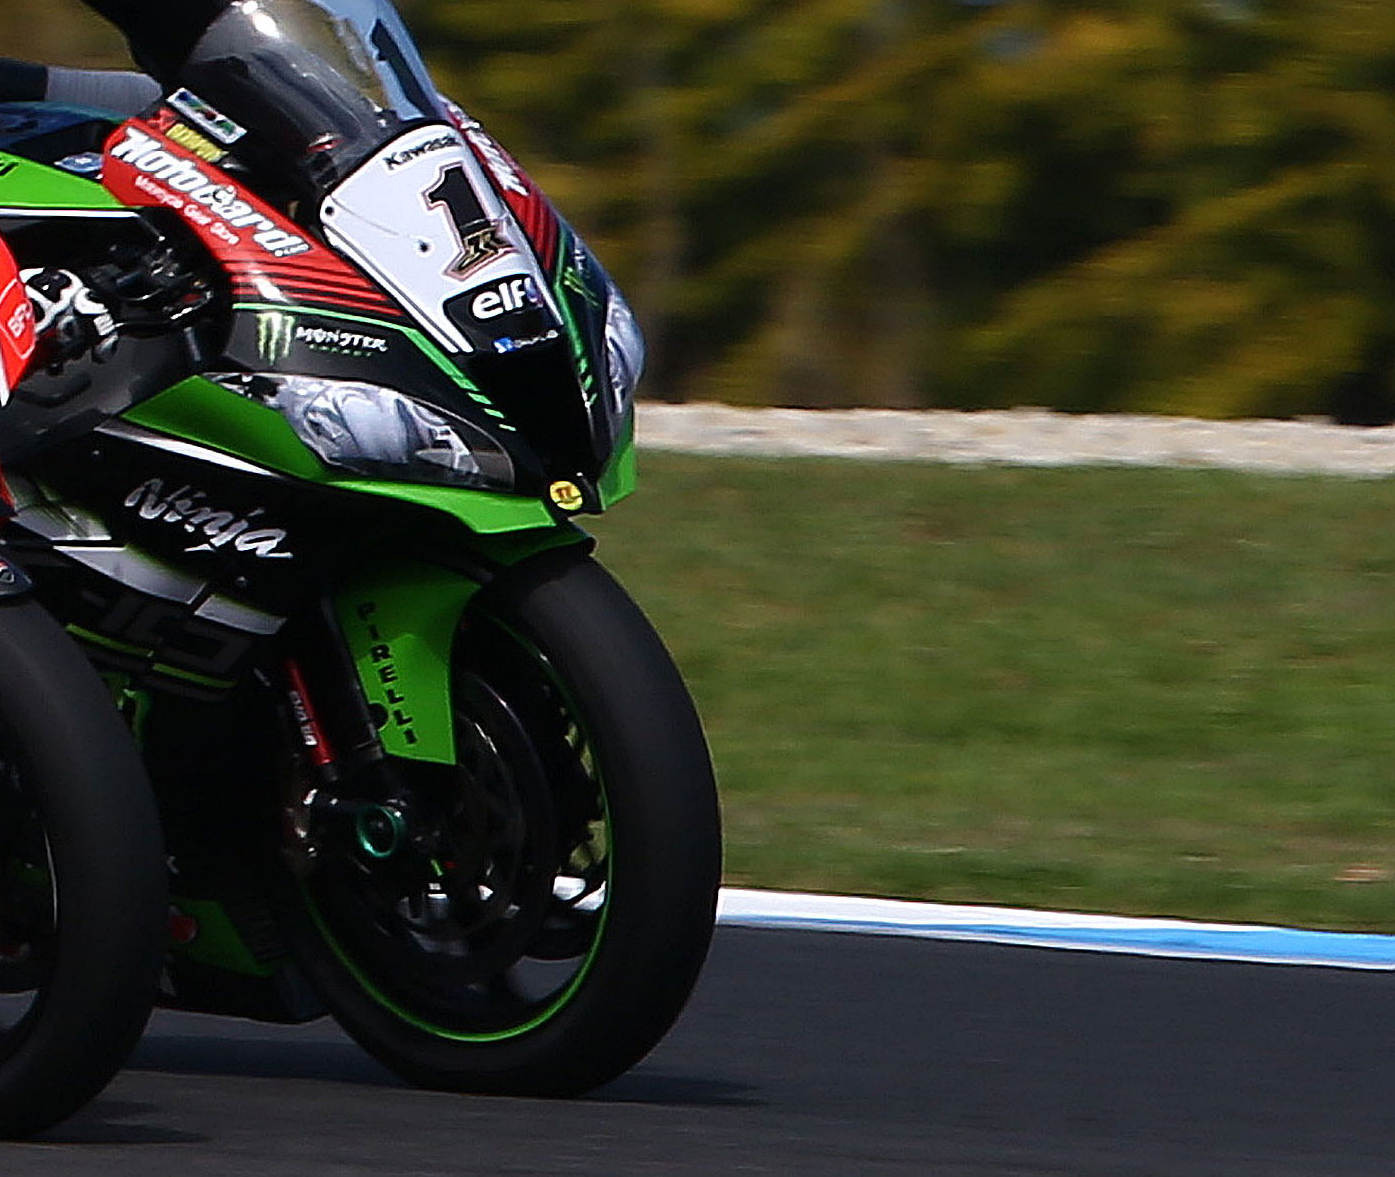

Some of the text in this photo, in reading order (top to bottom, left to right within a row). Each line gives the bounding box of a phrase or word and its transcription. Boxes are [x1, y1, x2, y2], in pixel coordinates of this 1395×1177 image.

[422, 161, 517, 281] 1
[296, 327, 388, 352] MONSTER
[472, 280, 526, 319] elf
[125, 477, 293, 559] Ninja
[359, 601, 417, 744] PIRELLI
